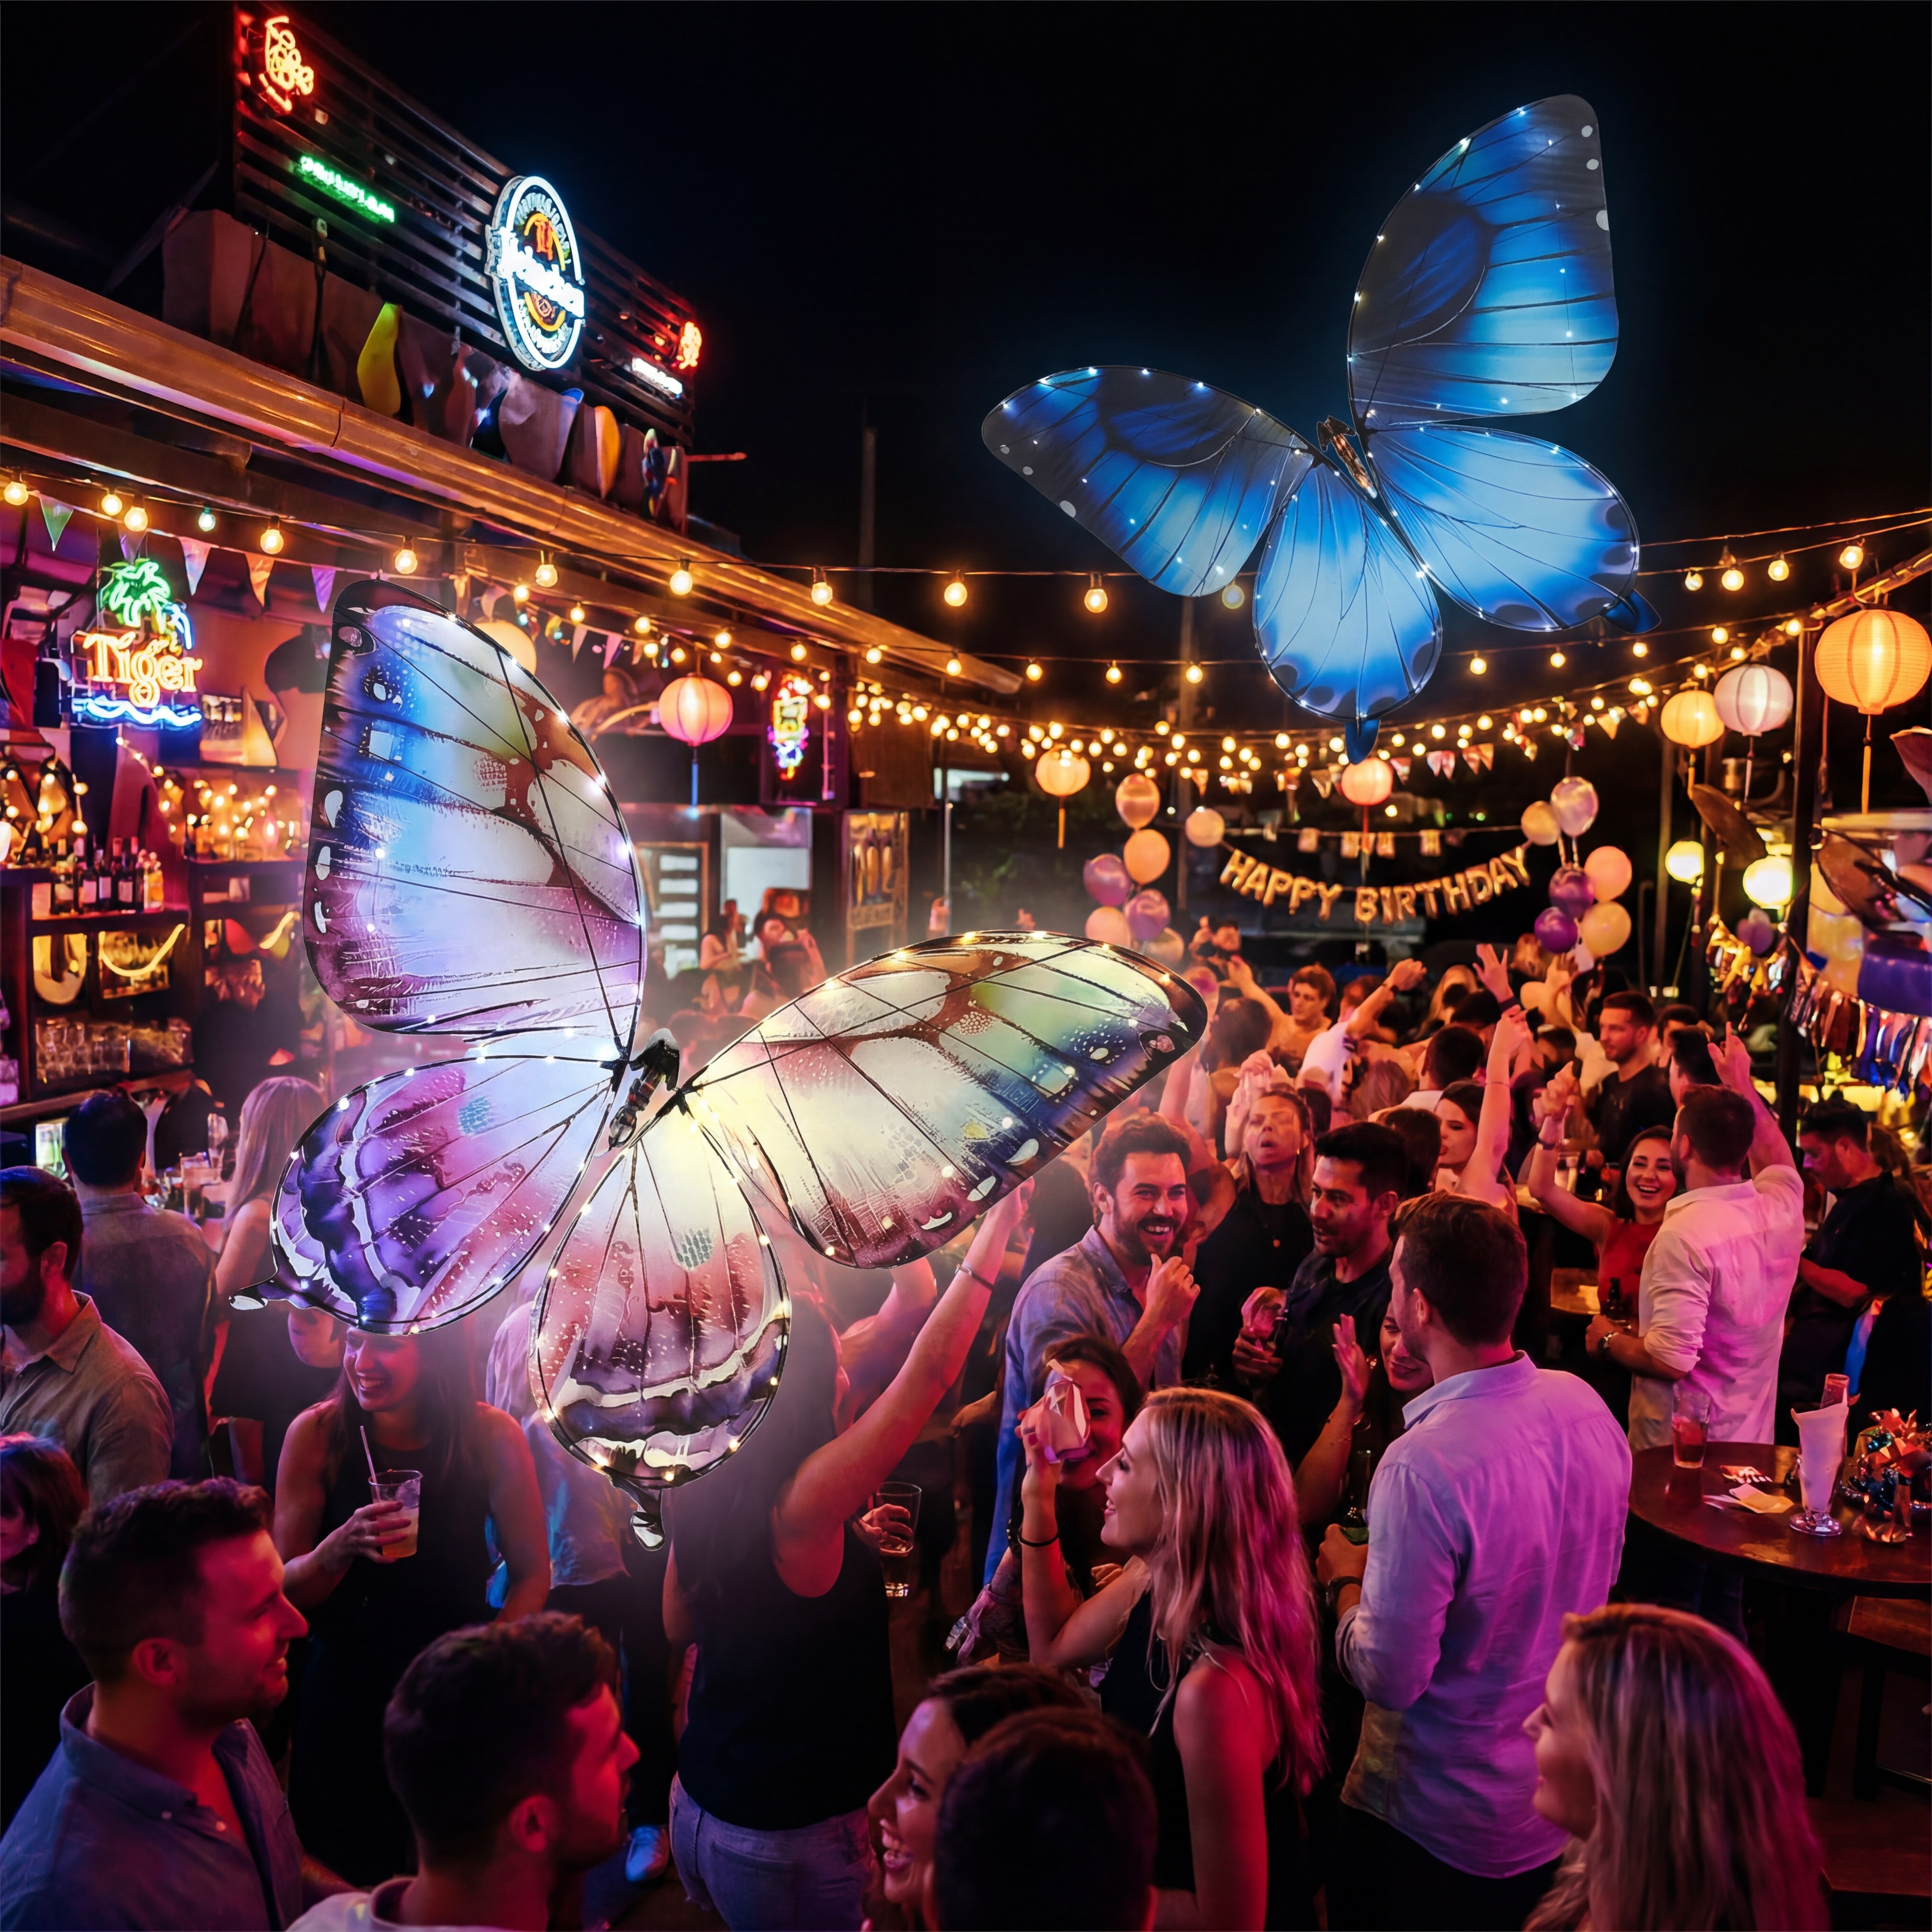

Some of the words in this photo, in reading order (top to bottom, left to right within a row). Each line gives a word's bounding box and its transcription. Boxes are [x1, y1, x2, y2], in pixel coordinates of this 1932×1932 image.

[83, 631, 203, 708] Tiger
[1220, 849, 1343, 920] HAPPY
[1354, 846, 1530, 924] BIRTHDAY
